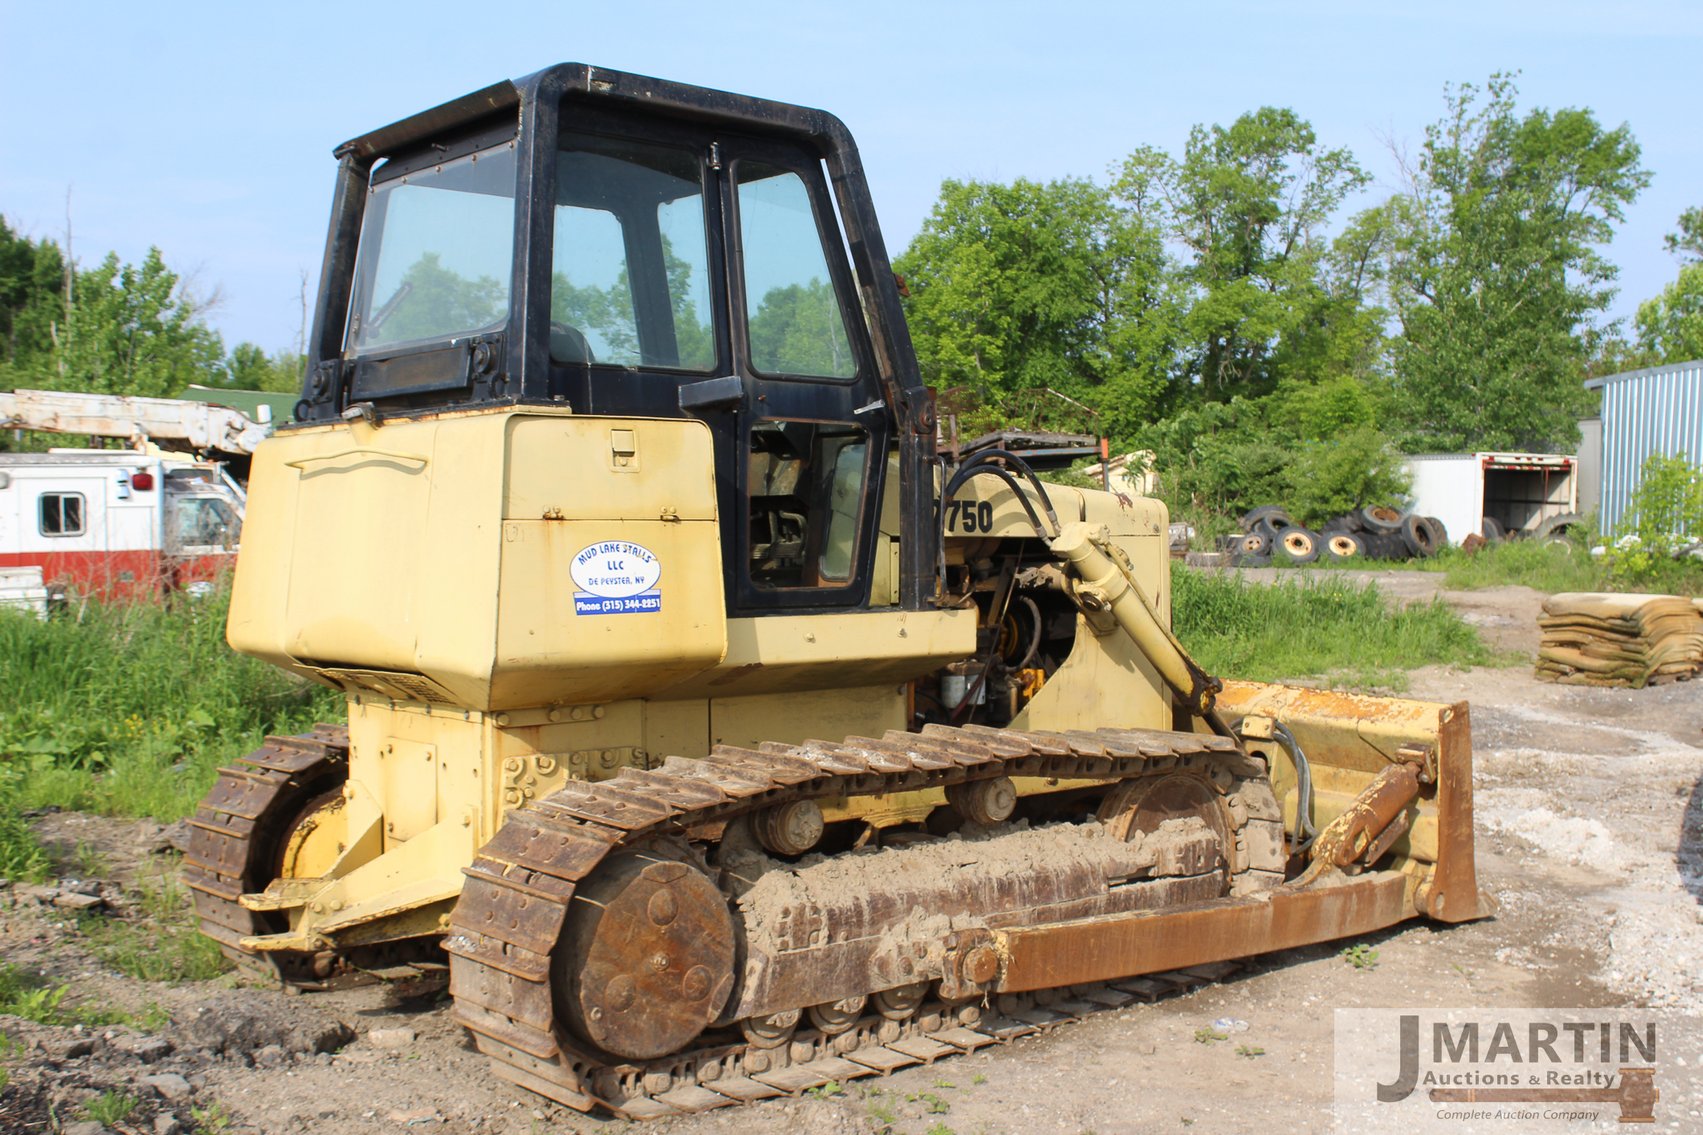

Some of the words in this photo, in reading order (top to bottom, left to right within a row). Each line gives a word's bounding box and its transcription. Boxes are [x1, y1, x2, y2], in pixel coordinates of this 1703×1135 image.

[934, 499, 993, 533] 750
[578, 548, 598, 565] MUD
[599, 543, 620, 554] LAKE
[607, 560, 624, 571] LLC
[588, 578, 598, 586] DE
[635, 576, 645, 584] NY
[576, 601, 601, 611] Phone
[602, 600, 624, 612] (315)
